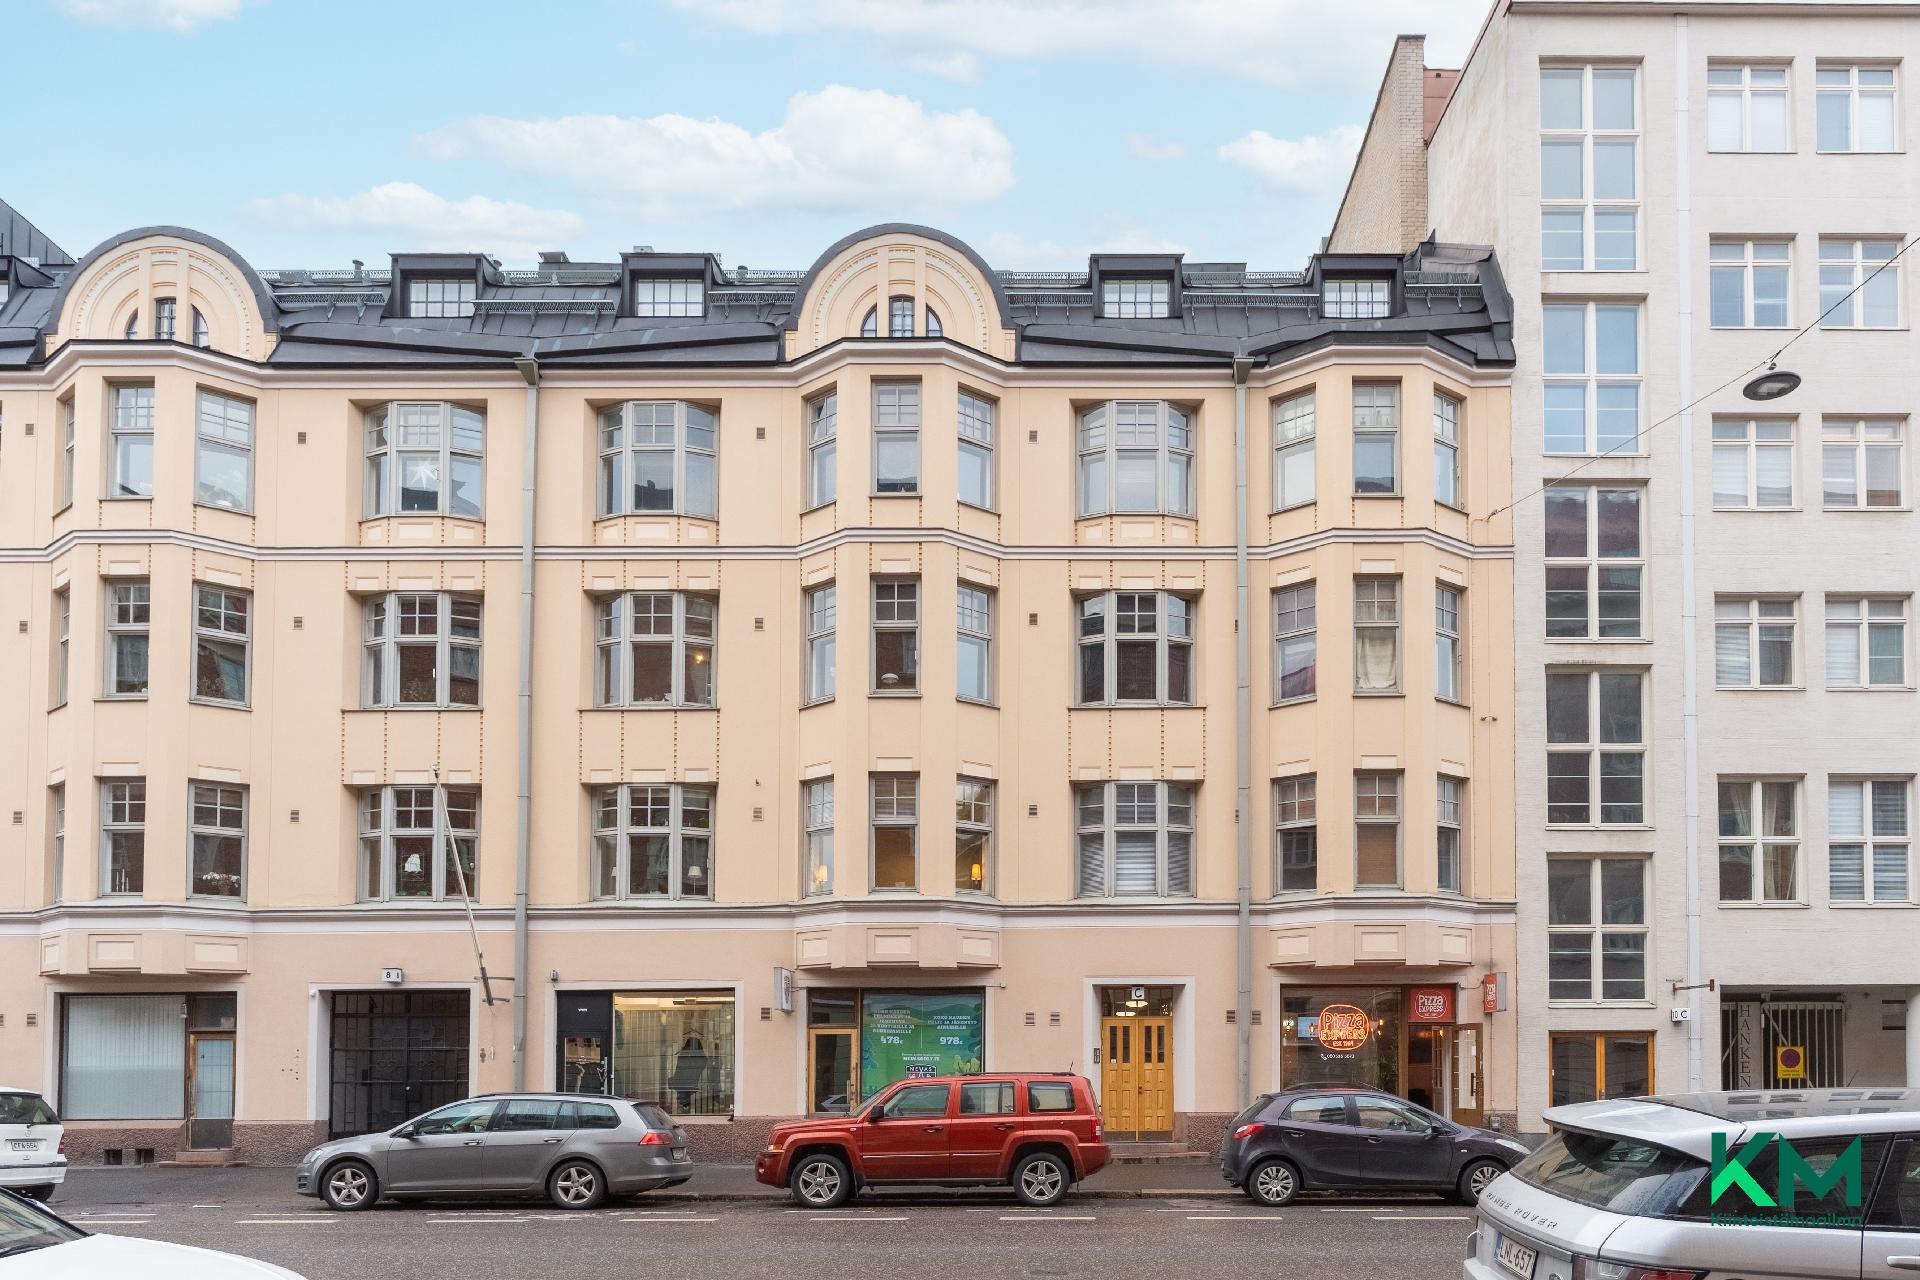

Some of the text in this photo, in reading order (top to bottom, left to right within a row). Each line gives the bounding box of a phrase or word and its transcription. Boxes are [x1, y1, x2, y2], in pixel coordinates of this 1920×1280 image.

[385, 971, 391, 979] 8
[1134, 987, 1142, 998] C
[1418, 995, 1444, 1006] Pizza
[1672, 1010, 1688, 1019] 10 C
[1323, 1011, 1365, 1031] Pizza
[1320, 1029, 1366, 1041] EXPRESS
[1740, 1005, 1752, 1088] HANKEN
[1486, 1192, 1558, 1230] RANGE ROVER
[1499, 1238, 1533, 1274] LNL-657
